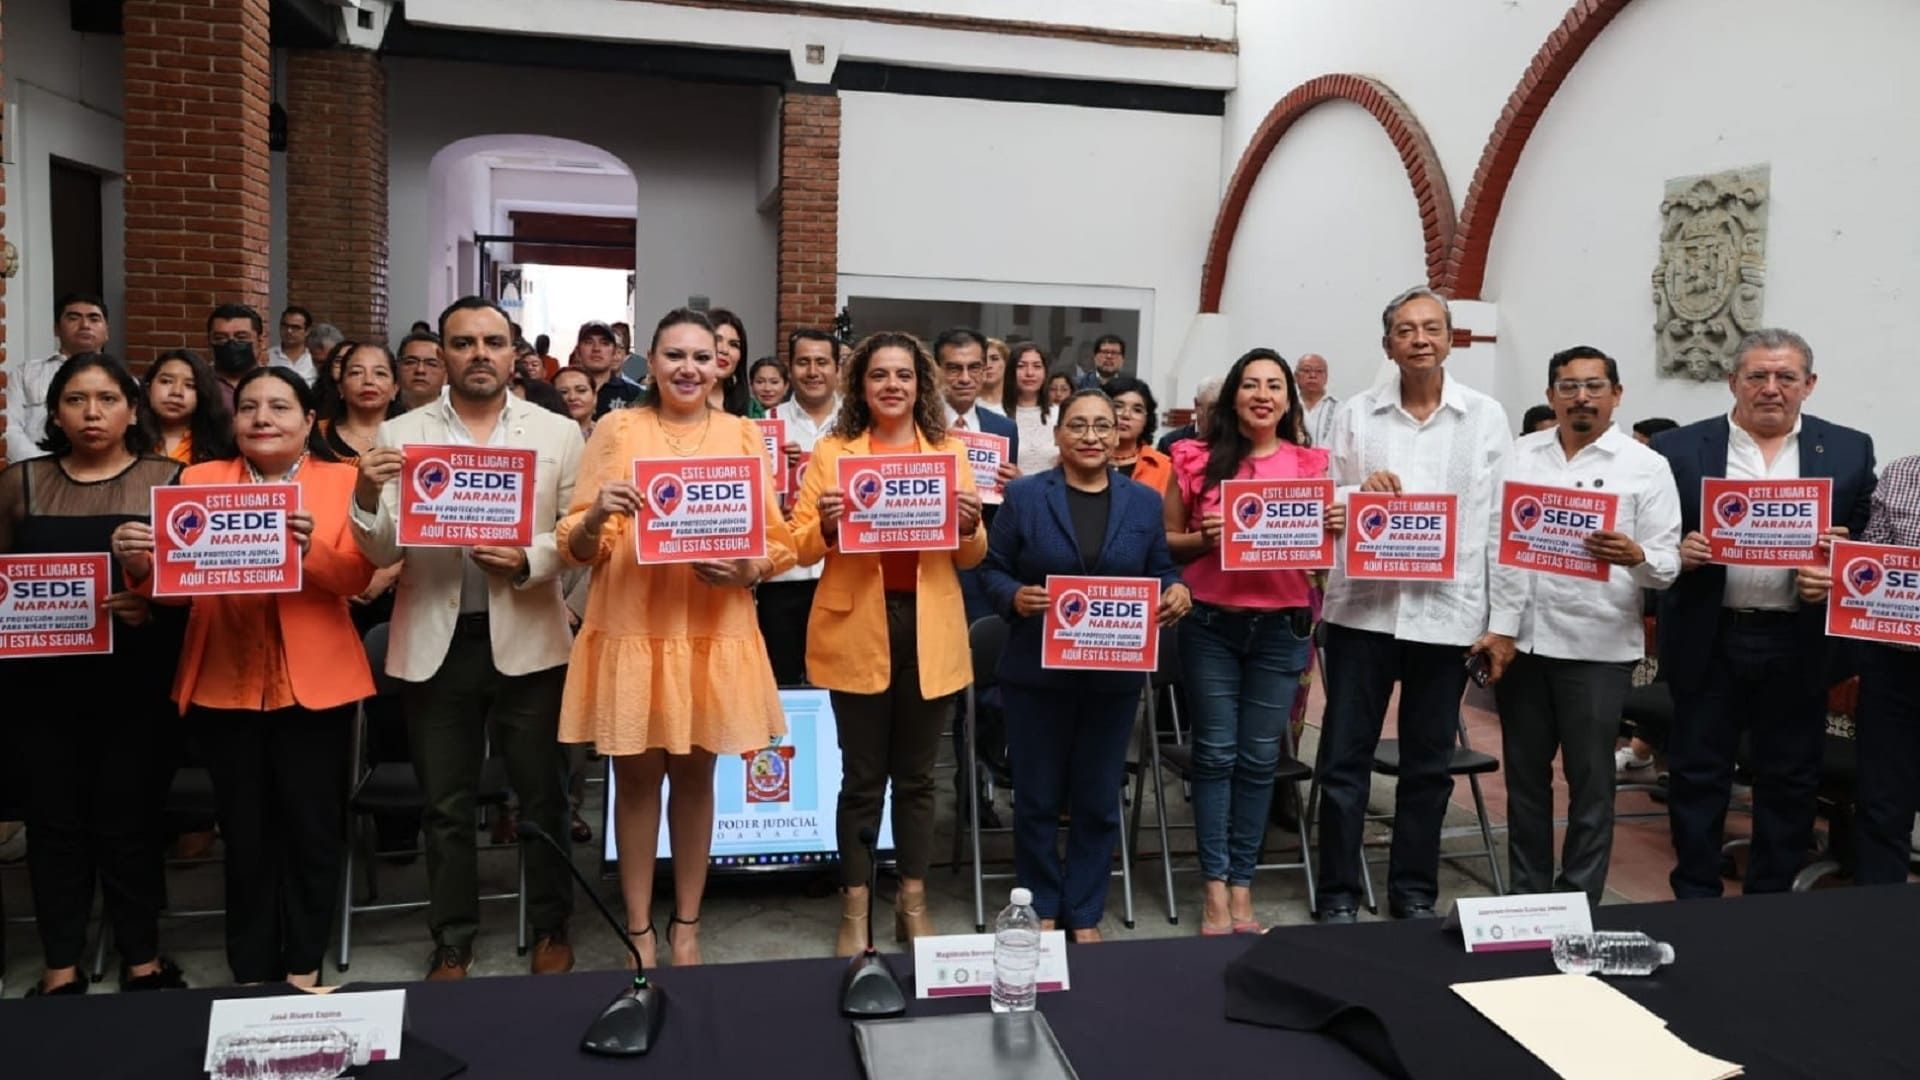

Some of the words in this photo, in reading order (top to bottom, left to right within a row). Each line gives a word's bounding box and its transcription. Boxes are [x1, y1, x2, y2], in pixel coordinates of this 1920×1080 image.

[451, 454, 474, 466] ESTE
[478, 456, 509, 468] LUGAR
[512, 457, 524, 468] ES
[968, 450, 996, 463] EDE
[682, 468, 705, 479] ESTE
[707, 467, 736, 478] LUGAR
[739, 466, 749, 477] ES
[881, 464, 903, 474] ESTE
[905, 463, 933, 474] LUGAR
[935, 463, 945, 473] ES
[455, 472, 516, 490] SEDE
[687, 484, 744, 501] SEDE
[886, 480, 940, 496] SEDE
[1263, 488, 1282, 498] ESTE
[1286, 487, 1312, 497] LUGAR
[1314, 487, 1323, 497] ES
[1749, 487, 1772, 498] ESTE
[1775, 488, 1804, 498] LUGAR
[1807, 487, 1818, 498] ES
[206, 495, 232, 508] ESTE
[236, 494, 269, 507] LUGAR
[272, 493, 285, 505] ES
[453, 492, 516, 502] NARANJA
[885, 498, 941, 508] NARANJA
[1543, 493, 1562, 506] ESTE
[1565, 496, 1593, 510] LUGAR
[1595, 500, 1607, 511] ES
[687, 504, 746, 514] NARANJA
[1267, 503, 1318, 517] SEDE
[1388, 502, 1407, 511] ESTE
[1410, 502, 1435, 511] LUGAR
[1437, 503, 1447, 512] ES
[1753, 503, 1812, 517] SEDE
[211, 512, 277, 530] SEDE
[1266, 520, 1318, 528] NARANJA
[1391, 516, 1440, 529] SEDE
[1544, 509, 1597, 529] SEDE
[420, 525, 444, 536] AQUÍ
[447, 525, 478, 538] ESTÁS
[480, 528, 518, 539] SEGURA
[860, 530, 879, 542] AQUÍ
[881, 529, 909, 542] ESTÁS
[910, 530, 944, 541] SEGURA
[1543, 526, 1586, 538] NARAN
[211, 533, 279, 545] NARANJA
[659, 538, 681, 553] AQUÍ
[683, 537, 712, 552] ESTÁS
[713, 538, 749, 550] SEGURA
[1241, 550, 1260, 562] AQUÍ
[1262, 548, 1287, 561] ESTÁS
[1290, 550, 1321, 560] SEGURA
[1722, 548, 1742, 559] AQUÍ
[1746, 548, 1776, 559] ESTÁS
[1778, 550, 1813, 560] SEGURA
[1364, 560, 1382, 571] AQUÍ
[1384, 560, 1410, 571] ESTÁS
[1412, 562, 1442, 572] SEGURA
[1516, 551, 1535, 562] AQUÍ
[1537, 554, 1562, 567] ESTÁS
[1565, 559, 1596, 573] SEGURA
[1883, 554, 1910, 568] ESTE
[8, 564, 37, 576] ESTE
[40, 564, 77, 576] LUGAR
[80, 563, 95, 575] ES
[180, 571, 204, 585] AQUÍ
[208, 568, 240, 583] ESTÁS
[243, 570, 283, 582] SEGURA
[14, 581, 86, 598] SEDE
[1088, 585, 1108, 596] ESTE
[1111, 586, 1136, 597] LUGAR
[1138, 588, 1148, 598] ES
[14, 600, 88, 611] NARANJA
[1090, 602, 1142, 617] SEDE
[1089, 620, 1142, 628] NARANJA
[1851, 618, 1875, 630] AQUÍ
[1878, 619, 1912, 635] ESTÁS
[11, 631, 47, 647] ESTÁS
[50, 633, 93, 646] SEGURA
[1062, 649, 1081, 660] AQUÍ
[1083, 650, 1109, 661] ESTÁS
[1111, 651, 1143, 662] SEGURA
[719, 820, 760, 829] PODER
[764, 817, 817, 828] JUDICIAL
